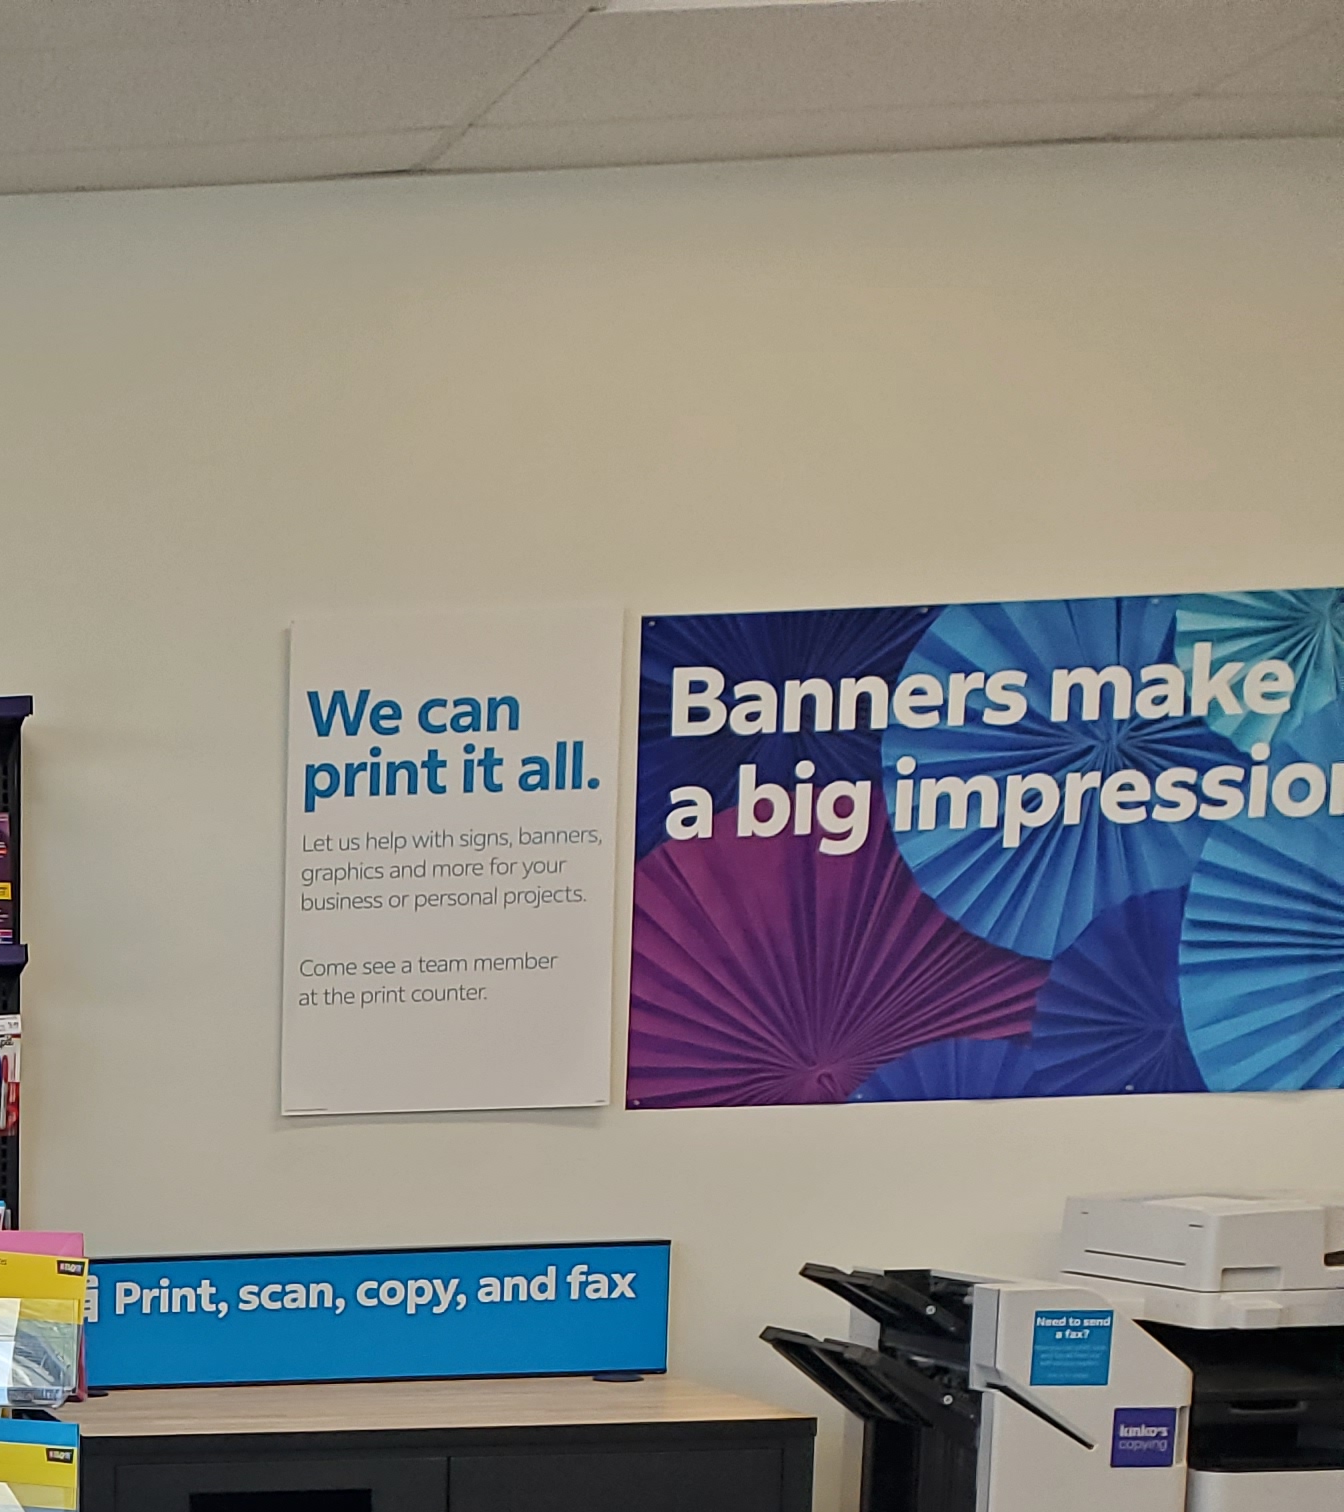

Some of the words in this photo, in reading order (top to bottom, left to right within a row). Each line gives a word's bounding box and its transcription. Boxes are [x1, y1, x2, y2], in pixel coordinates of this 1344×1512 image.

[671, 666, 1028, 737] Banners
[1050, 641, 1294, 723] make
[307, 689, 402, 736] We
[418, 693, 520, 732] can
[304, 747, 447, 812] print
[463, 743, 503, 793] it
[518, 741, 600, 790] all.
[665, 784, 712, 840] a
[737, 759, 872, 856] big
[302, 832, 333, 853] Let
[338, 834, 360, 851] us
[366, 830, 407, 855] help
[413, 829, 454, 849] with
[459, 828, 512, 852] signs,
[518, 825, 603, 849] banners,
[301, 861, 384, 886] graphics
[389, 860, 426, 880] and
[432, 862, 483, 879] more
[489, 857, 517, 876] for
[521, 858, 567, 880] your
[301, 891, 383, 911] business
[388, 894, 410, 909] or
[414, 888, 498, 912] personal
[503, 885, 587, 910] projects.
[299, 957, 357, 977] Come
[362, 960, 397, 976] see
[401, 960, 412, 975] a
[418, 956, 469, 974] team
[473, 954, 558, 972] member
[299, 989, 318, 1006] at
[323, 987, 355, 1006] the
[360, 984, 405, 1007] print
[411, 983, 487, 1003] counter.
[115, 1276, 229, 1319] Print,
[238, 1278, 346, 1316] scan,
[356, 1272, 468, 1314] copy,
[478, 1266, 556, 1303] and
[566, 1264, 637, 1300] fax
[1036, 1317, 1066, 1327] Need
[1068, 1317, 1081, 1327] to
[1083, 1317, 1110, 1326] send
[1055, 1331, 1063, 1339] a
[1065, 1329, 1090, 1339] fax?
[1119, 1439, 1167, 1451] copying
